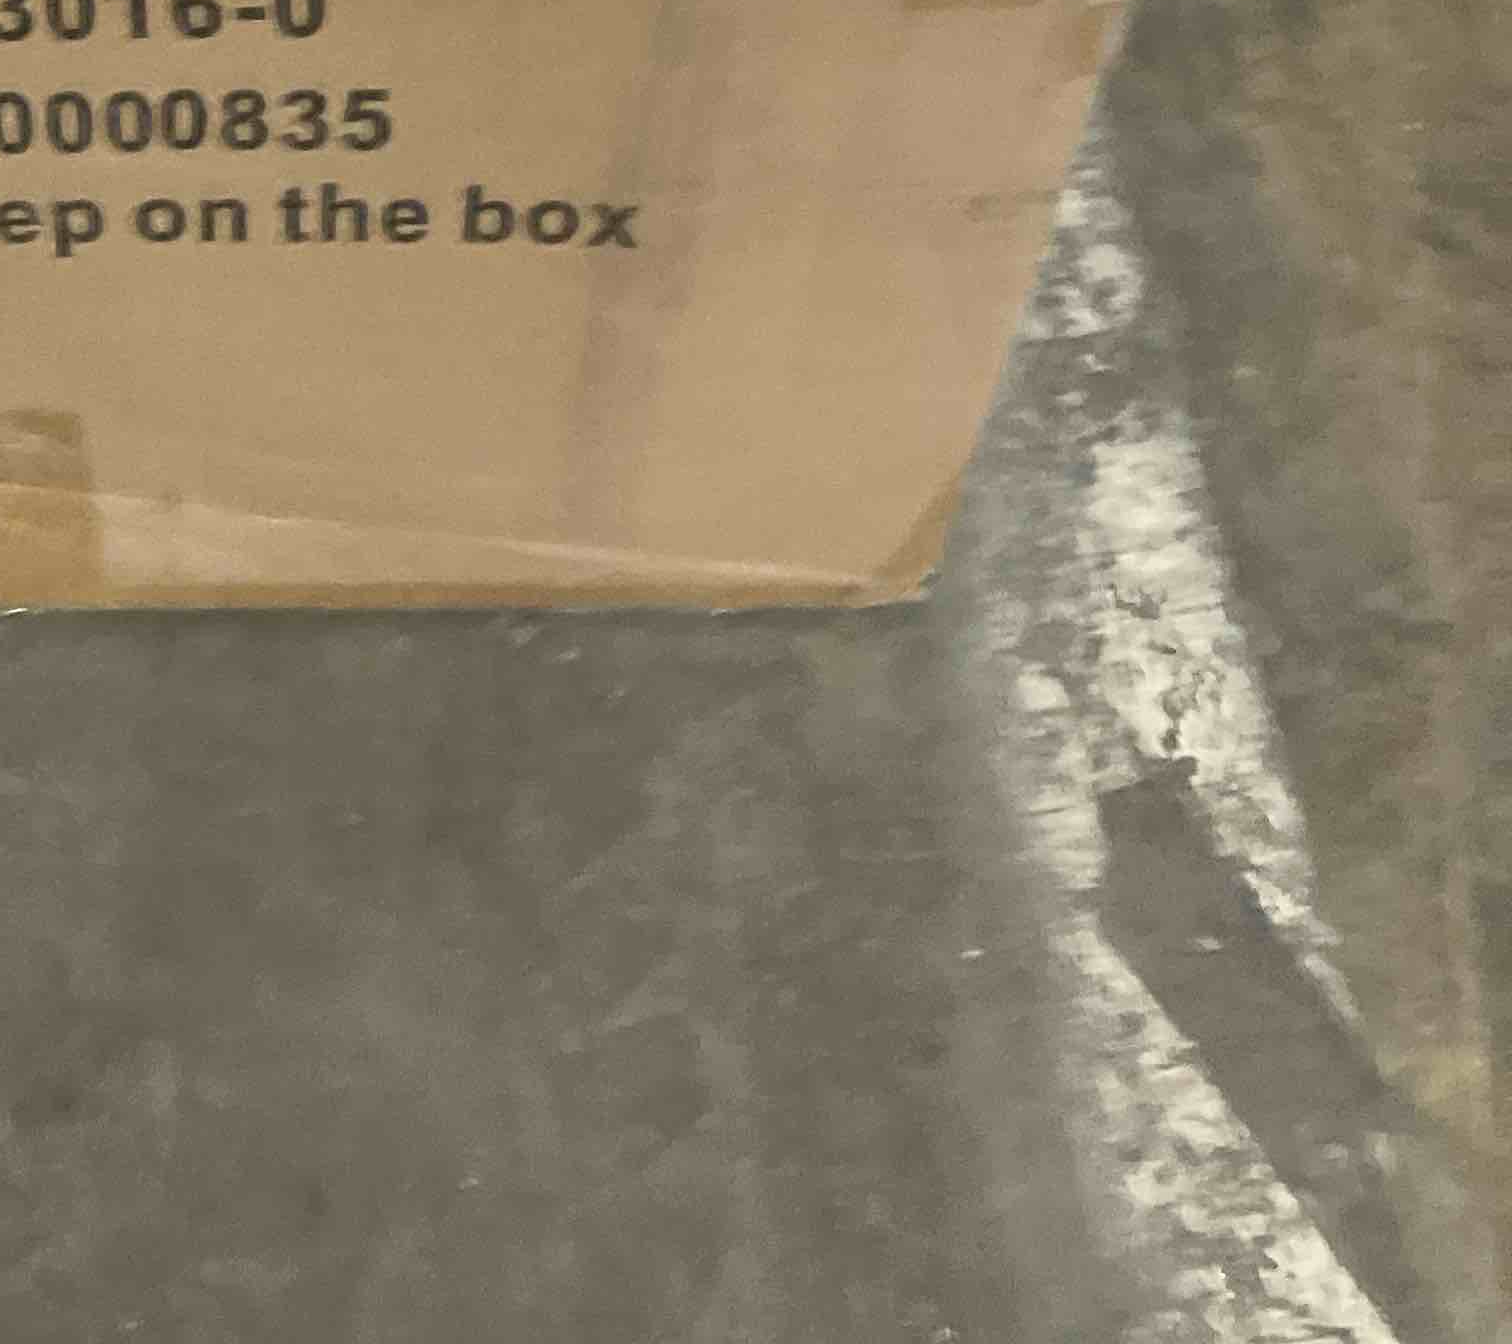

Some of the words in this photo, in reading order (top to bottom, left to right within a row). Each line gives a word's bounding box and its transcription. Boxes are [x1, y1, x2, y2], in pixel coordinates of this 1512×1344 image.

[133, 194, 249, 244] on
[277, 182, 431, 244] the
[460, 183, 639, 249] box
